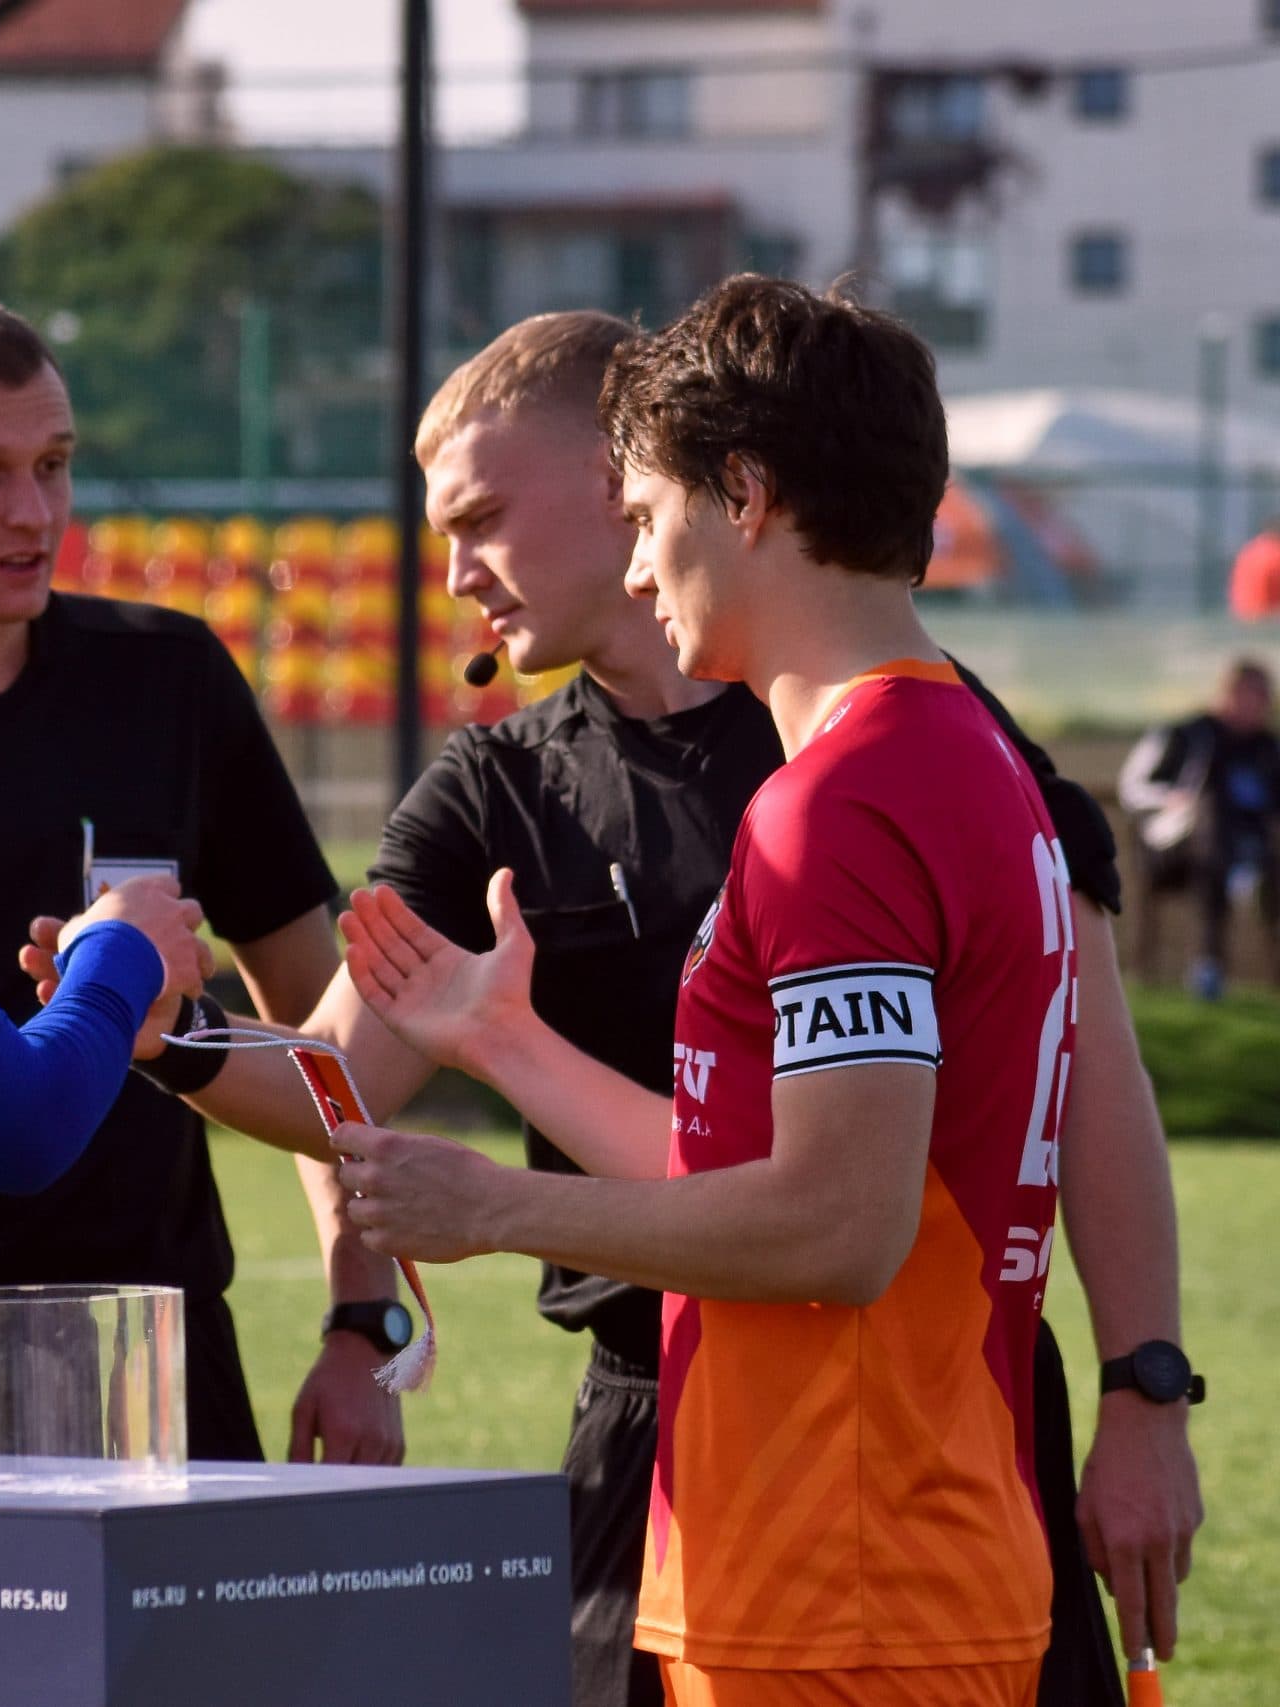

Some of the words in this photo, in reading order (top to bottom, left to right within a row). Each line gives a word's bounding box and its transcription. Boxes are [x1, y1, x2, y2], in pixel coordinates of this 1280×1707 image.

[0, 1588, 68, 1611] RFS.RU
[132, 1585, 187, 1609] RFS.RU
[215, 1570, 318, 1602] РОССИЙСКИЙ
[322, 1563, 425, 1592] ФУТБОЛЬНЫЙ
[429, 1562, 474, 1585] СОЮЗ
[502, 1554, 553, 1579] RFS.RU
